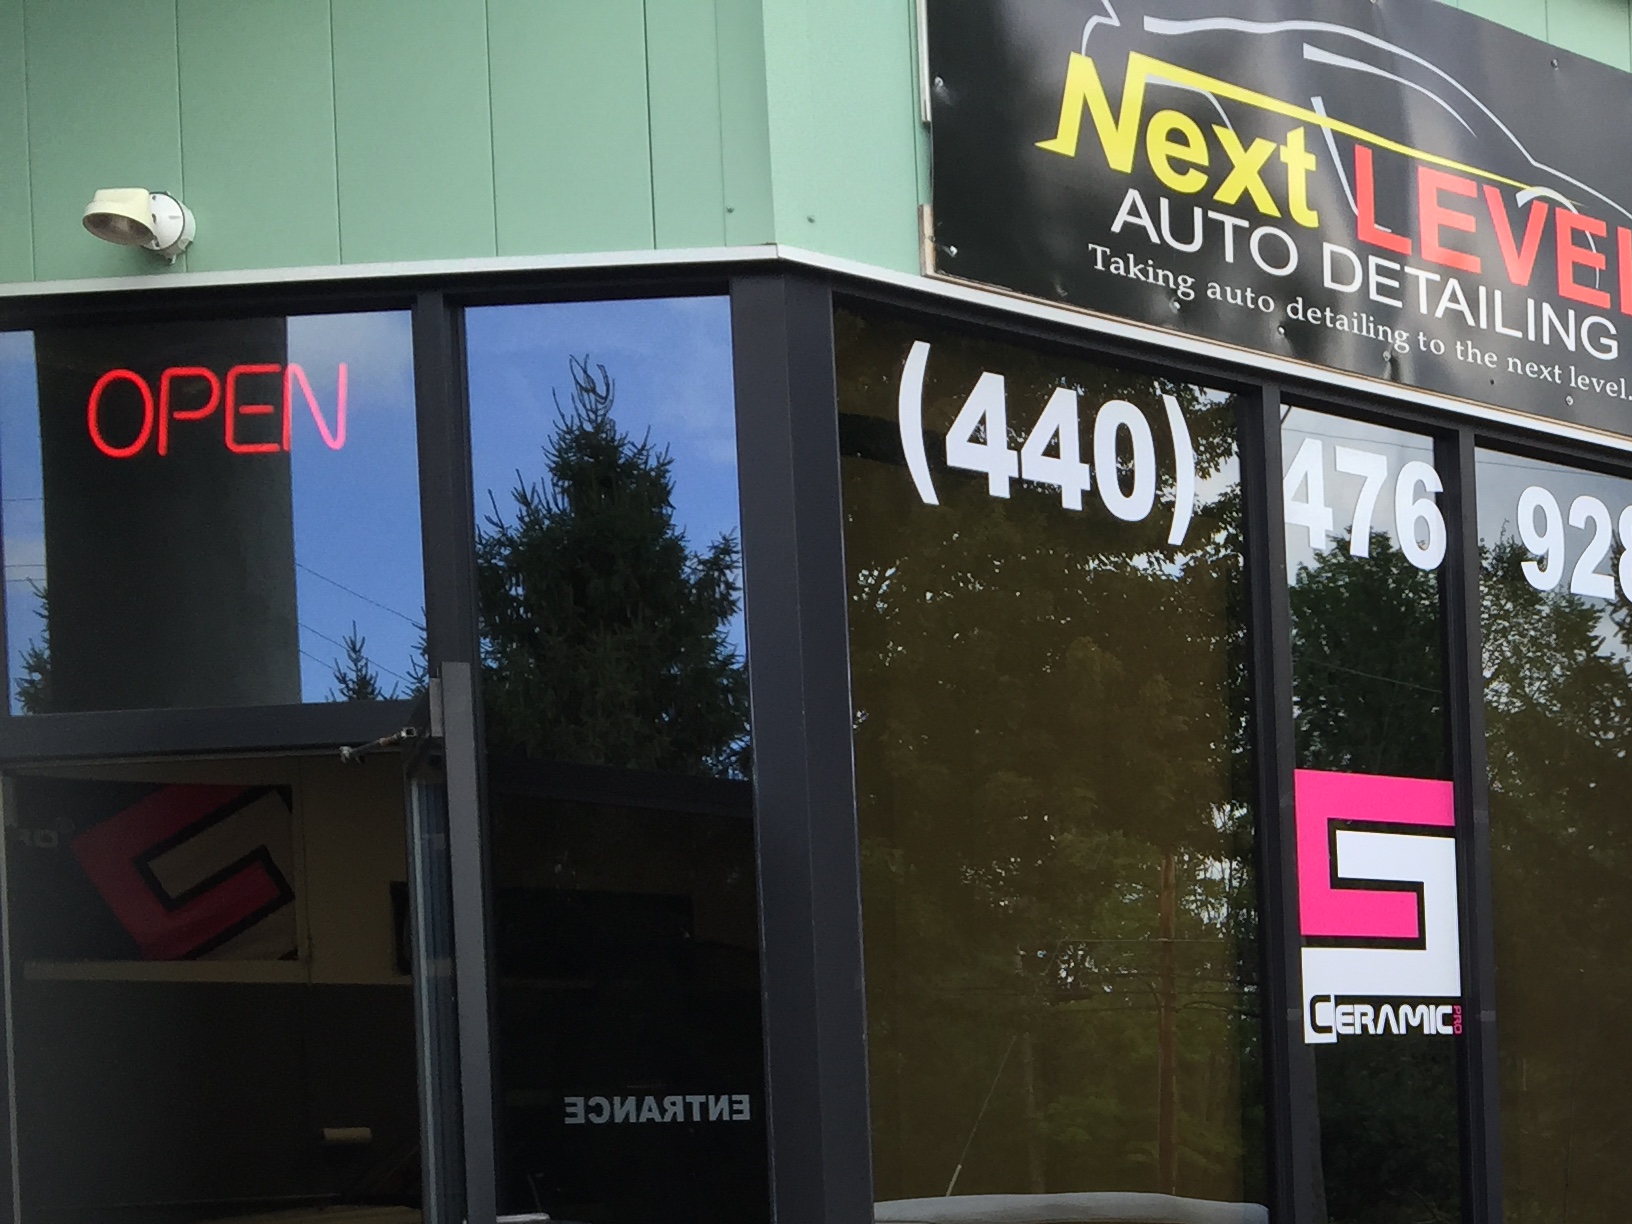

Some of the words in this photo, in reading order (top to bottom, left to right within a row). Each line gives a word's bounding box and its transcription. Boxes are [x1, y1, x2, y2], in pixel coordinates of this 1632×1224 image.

[1034, 51, 1319, 228] Next
[1088, 244, 1196, 300] Taking
[1206, 281, 1275, 313] auto
[1286, 296, 1410, 353] detailing
[1418, 332, 1446, 355] to
[1455, 340, 1498, 368] the
[1507, 355, 1562, 385] next
[1110, 188, 1299, 276] AUTO
[1323, 242, 1619, 361] DETAILING
[86, 361, 349, 459] OPEN
[899, 340, 1195, 545] (440)
[1282, 437, 1447, 571] 476
[1310, 994, 1454, 1035] CERAMIC
